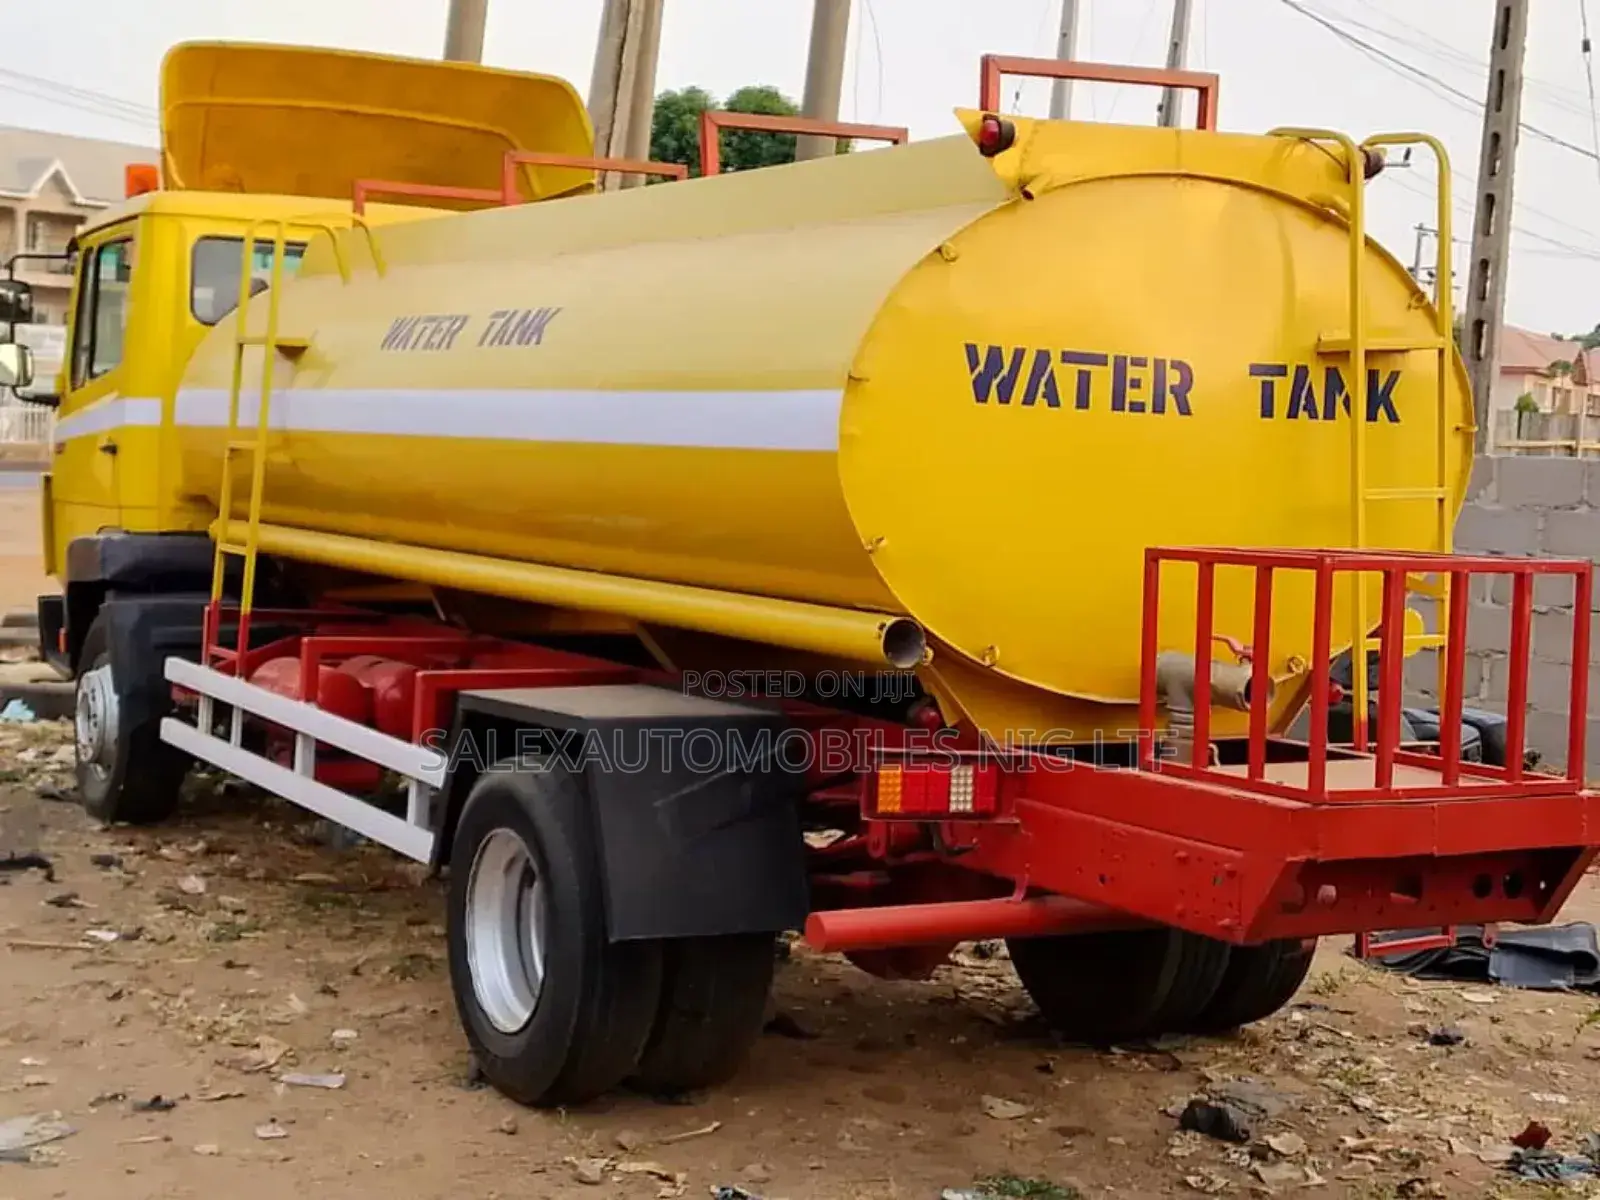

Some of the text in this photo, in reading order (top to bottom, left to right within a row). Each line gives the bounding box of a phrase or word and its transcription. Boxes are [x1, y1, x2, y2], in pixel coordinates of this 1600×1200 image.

[380, 306, 564, 351] WATER TANK
[964, 342, 1402, 424] WATER TANK
